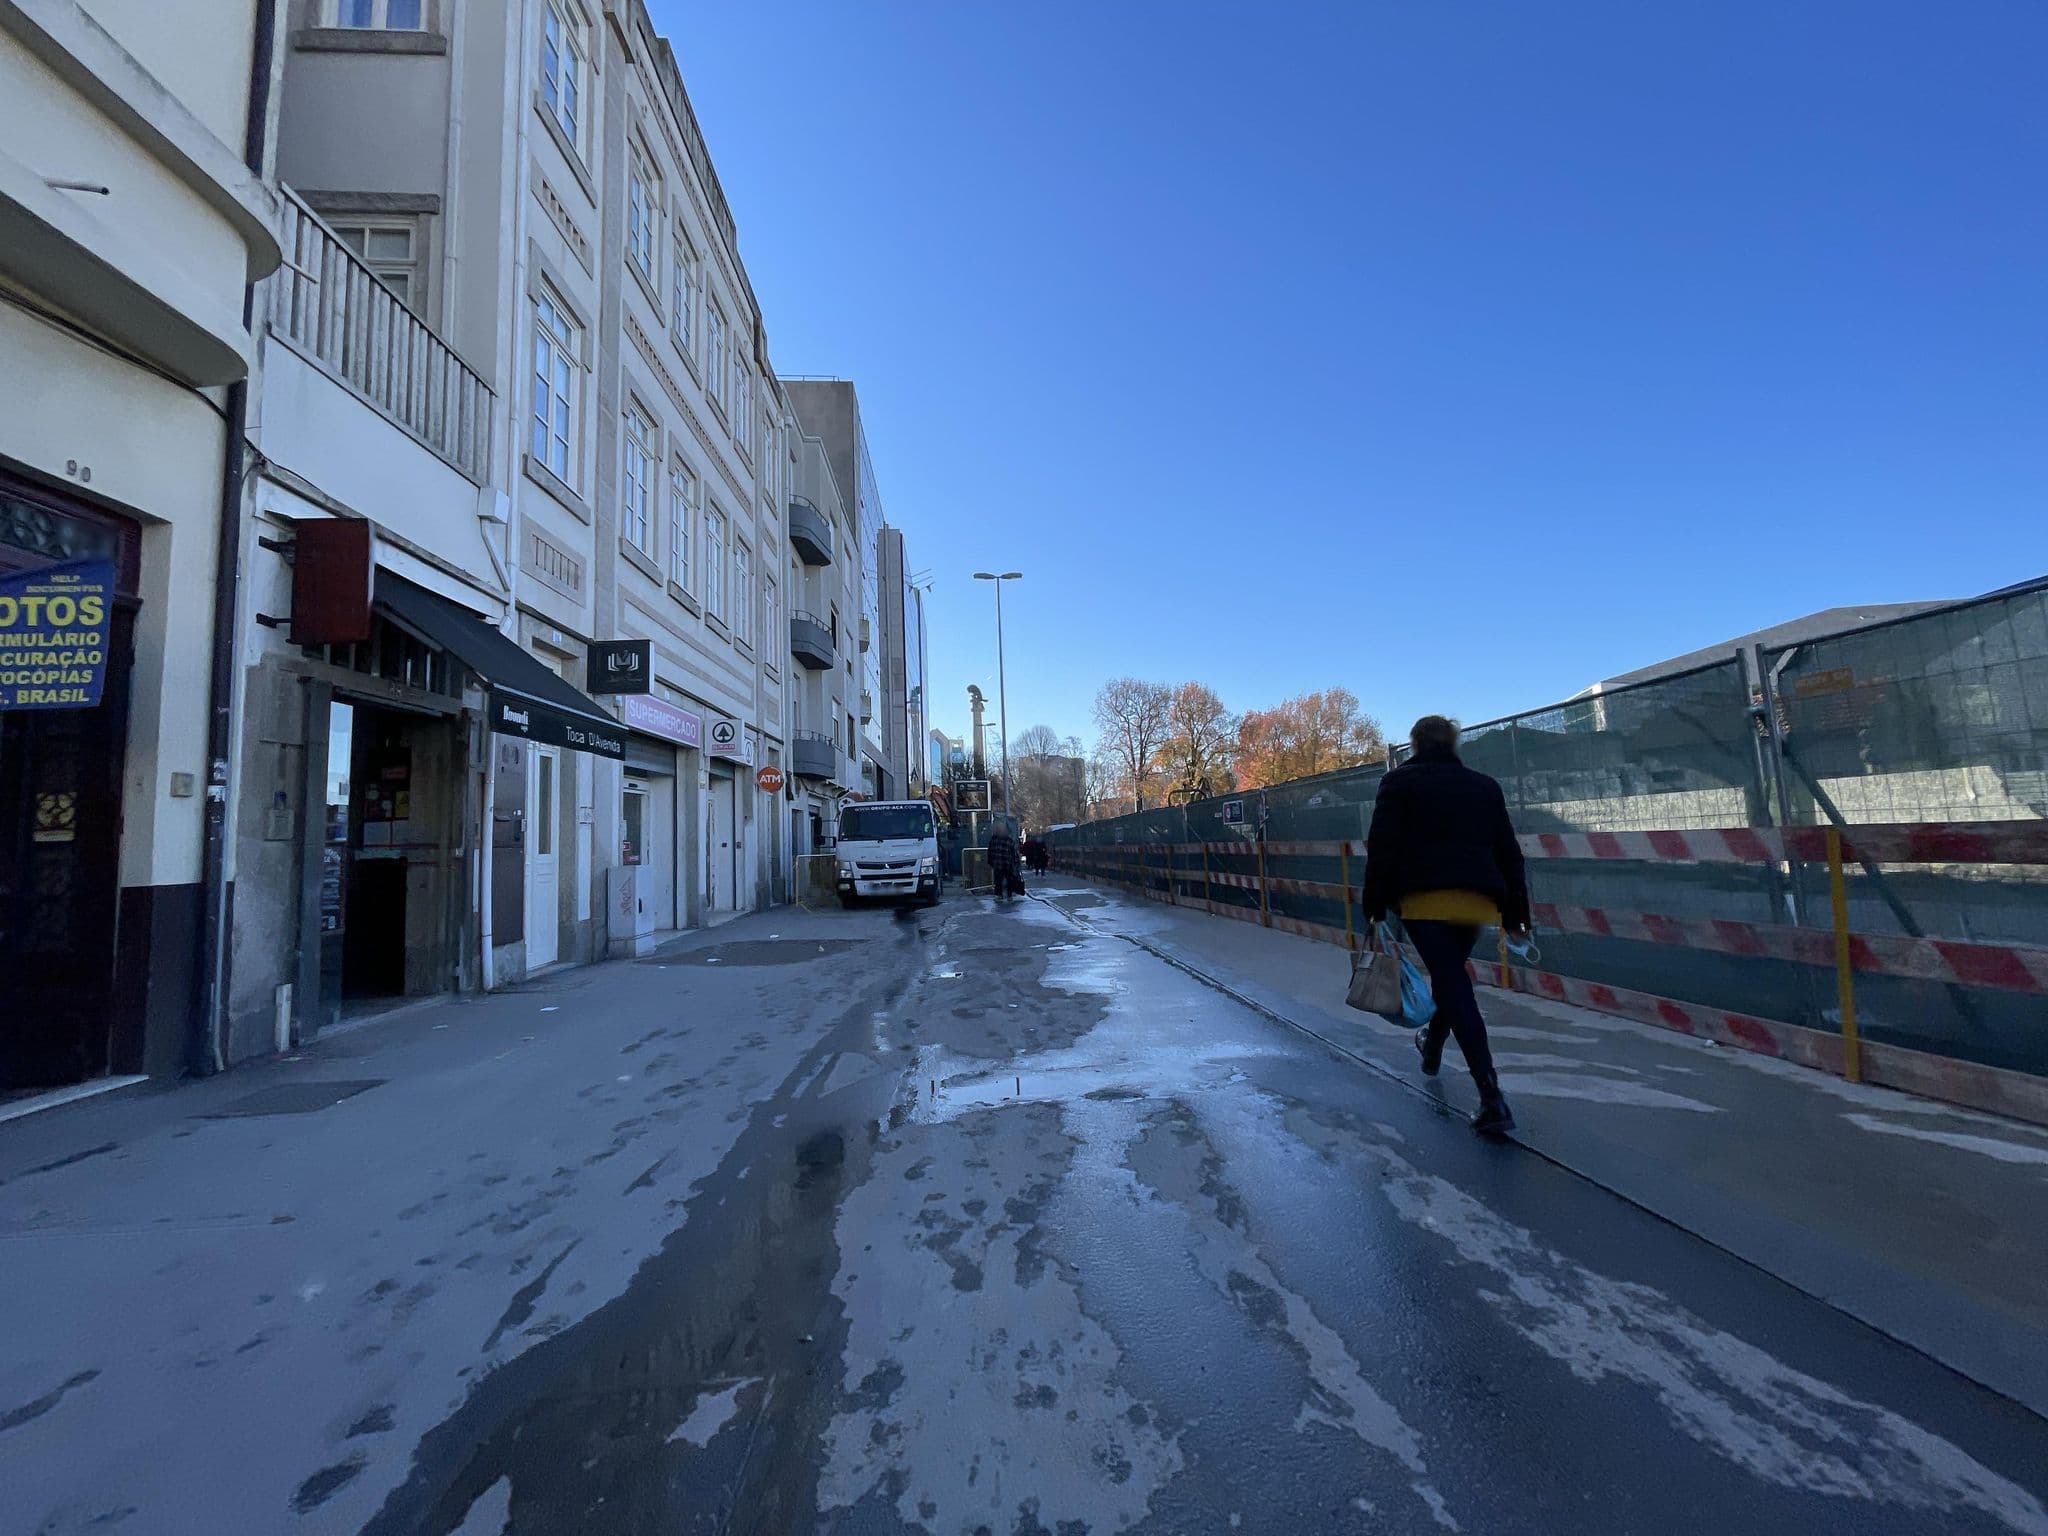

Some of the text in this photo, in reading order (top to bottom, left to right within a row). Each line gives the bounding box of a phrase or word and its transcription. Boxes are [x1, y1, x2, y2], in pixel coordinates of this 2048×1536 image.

[66, 459, 91, 482] 90
[0, 596, 104, 626] OTOS
[0, 668, 93, 685] OCÓPIAS
[16, 689, 90, 704] BRASIL
[629, 699, 697, 739] SUPERMERCADO
[566, 726, 621, 753] Toca D'Avenida
[759, 774, 781, 783] ATM
